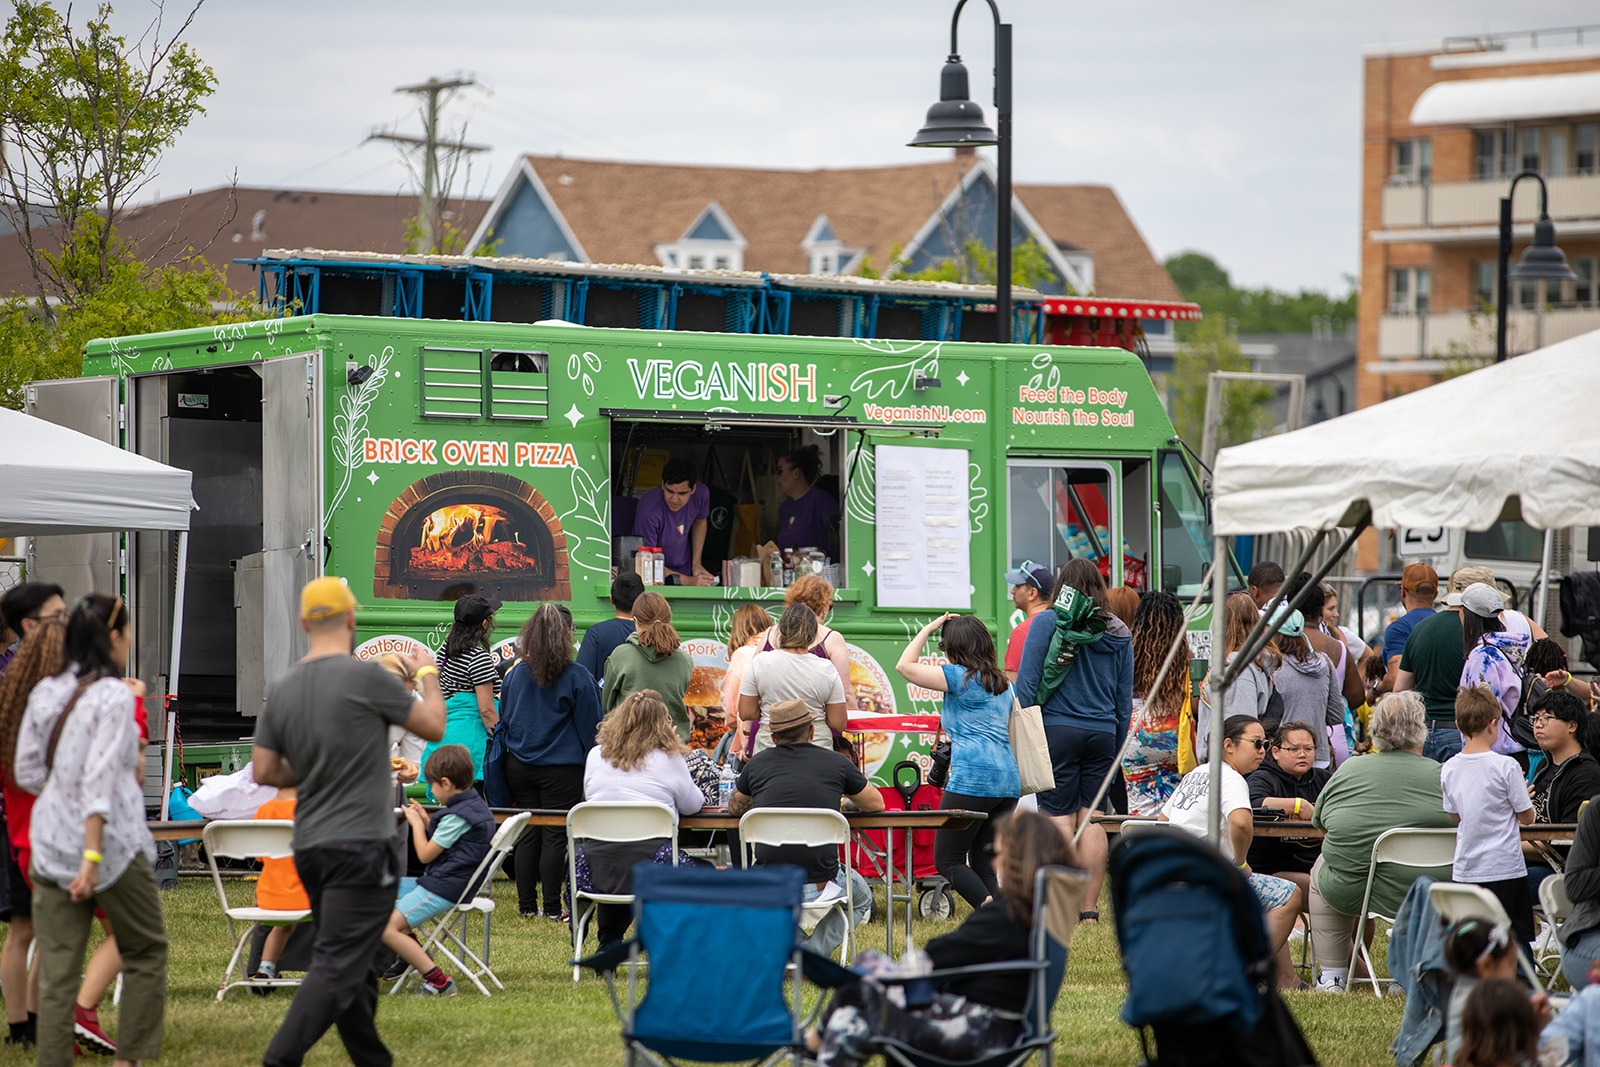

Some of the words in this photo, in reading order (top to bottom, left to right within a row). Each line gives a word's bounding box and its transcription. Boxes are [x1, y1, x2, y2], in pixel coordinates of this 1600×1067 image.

[628, 359, 816, 401] VEGANISH
[1020, 386, 1056, 402] Feed
[1060, 387, 1085, 403] the
[1089, 388, 1127, 407] Body
[864, 404, 986, 422] VeganishNJ.com
[1013, 407, 1069, 425] Nourish
[1073, 409, 1098, 425] the
[1101, 409, 1134, 426] Soul
[364, 439, 436, 463] BRICK
[443, 441, 508, 465] OVEN
[516, 443, 577, 467] PIZZA
